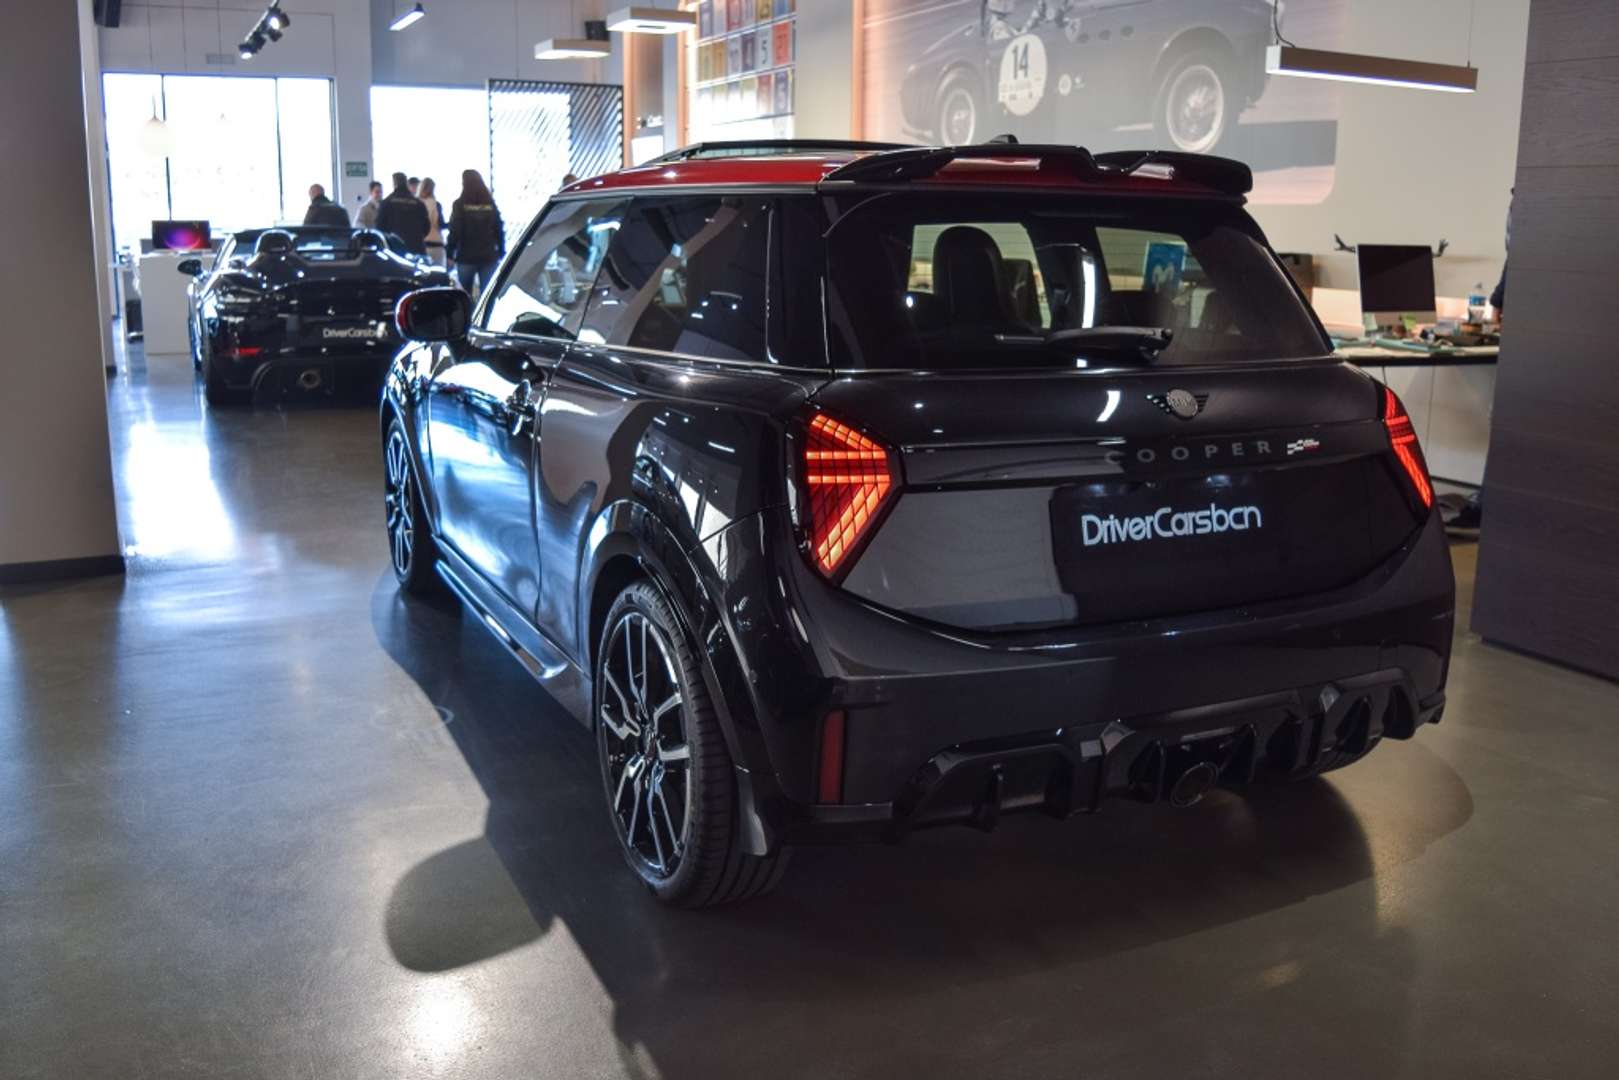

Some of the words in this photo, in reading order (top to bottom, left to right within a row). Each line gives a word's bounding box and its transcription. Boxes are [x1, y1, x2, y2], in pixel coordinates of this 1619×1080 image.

[1011, 42, 1029, 80] 14
[322, 327, 389, 338] DriverCarsbn
[1104, 440, 1272, 465] COOPER
[1081, 503, 1262, 546] DriverCarsbcn
